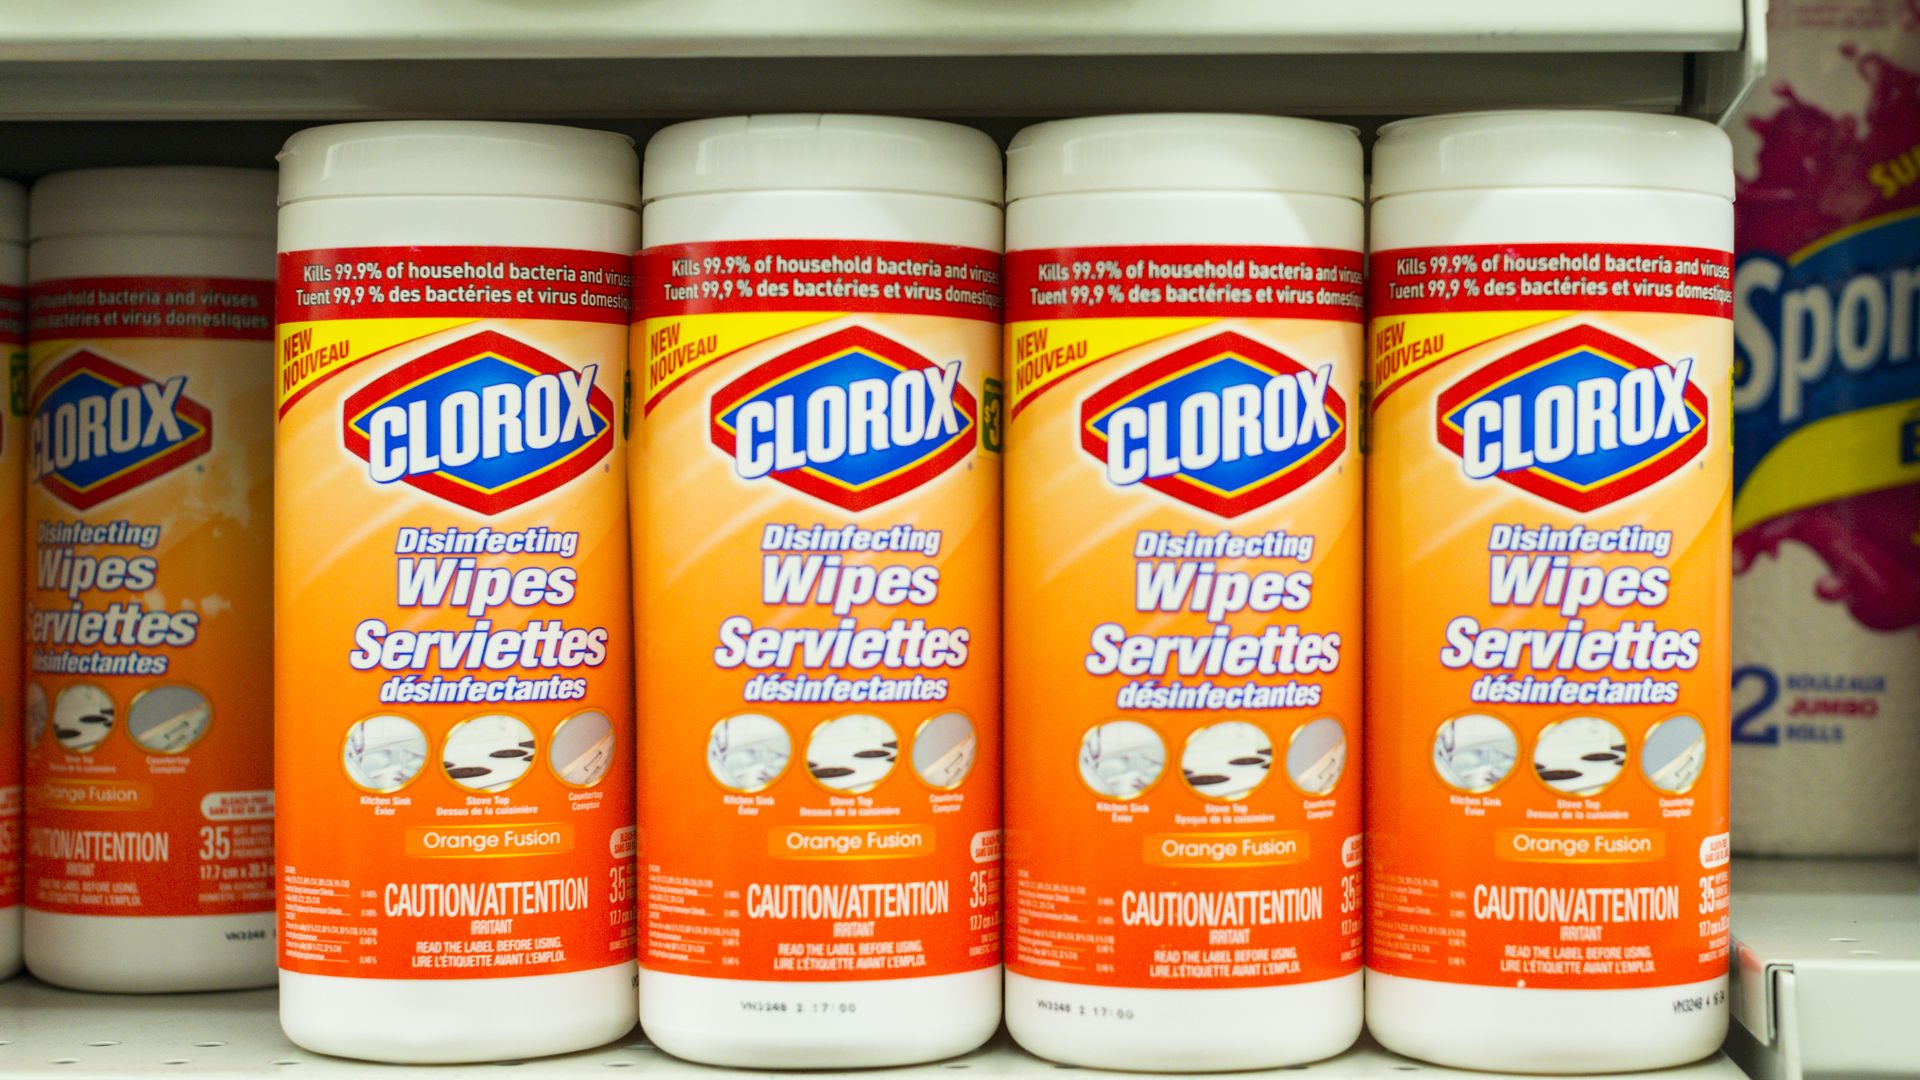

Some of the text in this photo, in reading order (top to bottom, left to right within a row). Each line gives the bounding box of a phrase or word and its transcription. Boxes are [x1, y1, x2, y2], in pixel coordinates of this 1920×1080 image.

[304, 261, 602, 285] Kills 99.9% of household bacteria and
[672, 256, 967, 280] Kills 99.9% of household bacteria and
[1039, 260, 1337, 282] Kills 99.9% of household bacteria and
[1397, 253, 1730, 280] Kills 99.9% of household bacteria and viruses
[98, 288, 160, 305] bacteria
[165, 288, 195, 305] and
[200, 288, 259, 307] viruses
[296, 284, 576, 307] Tuent 99,9 % des bactéries et virus
[664, 278, 942, 300] Tuent 99,9 % des bactéries et virus
[1031, 283, 1314, 307] Tuent 99,9 % des bactéries et virus
[1389, 277, 1732, 304] Tuent 99,9 % des bactéries et virus domestiques
[122, 310, 161, 326] virus
[166, 309, 268, 331] domestiques
[284, 328, 312, 365] NEW
[650, 323, 680, 358] NEW
[1016, 328, 1048, 364] NEW
[1376, 321, 1405, 356] NEW
[283, 340, 350, 395] NOUVEAU
[650, 335, 718, 390] NOUVEAU
[1015, 340, 1087, 394] NOUVEAU
[1375, 334, 1444, 389] NOUVEAU
[32, 375, 188, 484] CLOROX
[369, 363, 598, 484] CLOROX
[736, 360, 962, 479] CLOROX
[1107, 364, 1333, 486] CLOROX
[1463, 358, 1693, 479] CLOROX
[395, 527, 579, 558] Disinfecting
[761, 524, 942, 556] Disinfecting
[1134, 530, 1314, 562] Disinfecting
[1488, 524, 1672, 557] Disinfecting
[37, 547, 157, 599] Wipes
[397, 558, 577, 616] Wipes
[762, 555, 940, 615] Wipes
[1490, 555, 1670, 616] Wipes
[1135, 561, 1312, 622] Wipes
[349, 619, 608, 670] Serviettes
[713, 616, 970, 669] Serviettes
[1086, 622, 1341, 675] Serviettes
[1440, 616, 1700, 670] Serviettes
[379, 675, 587, 703] désinfectantes
[744, 673, 948, 702] désinfectantes
[1117, 680, 1321, 709] désinfectantes
[1471, 674, 1679, 704] désinfectantes
[1731, 664, 1780, 745] 2
[89, 785, 138, 802] Fusion
[466, 796, 510, 807] Stove Top
[199, 826, 231, 861] 35
[424, 830, 560, 851] Orange Fusion
[786, 831, 921, 853] Orange Fusion
[1162, 839, 1296, 861] Orange Fusion
[1513, 834, 1651, 855] Orange Fusion
[384, 877, 588, 917] CAUTION/ATTENTION
[609, 866, 626, 904] 35
[747, 880, 949, 919] CAUTION/ATTENTION
[970, 870, 987, 908] 35
[1341, 875, 1355, 913] 35
[1699, 875, 1714, 914] 35
[1122, 887, 1322, 926] CAUTION/ATTENTION
[1474, 885, 1679, 923] CAUTION/ATTENTION
[471, 919, 513, 935] IRRITANT
[833, 921, 875, 937] IRRITANT
[1209, 929, 1250, 945] IRRITANT
[1560, 926, 1603, 941] IRRITANT
[412, 954, 432, 967] LIRE
[494, 954, 524, 966] AVANT
[416, 937, 563, 954] READ THE LABEL BEFORE USING.
